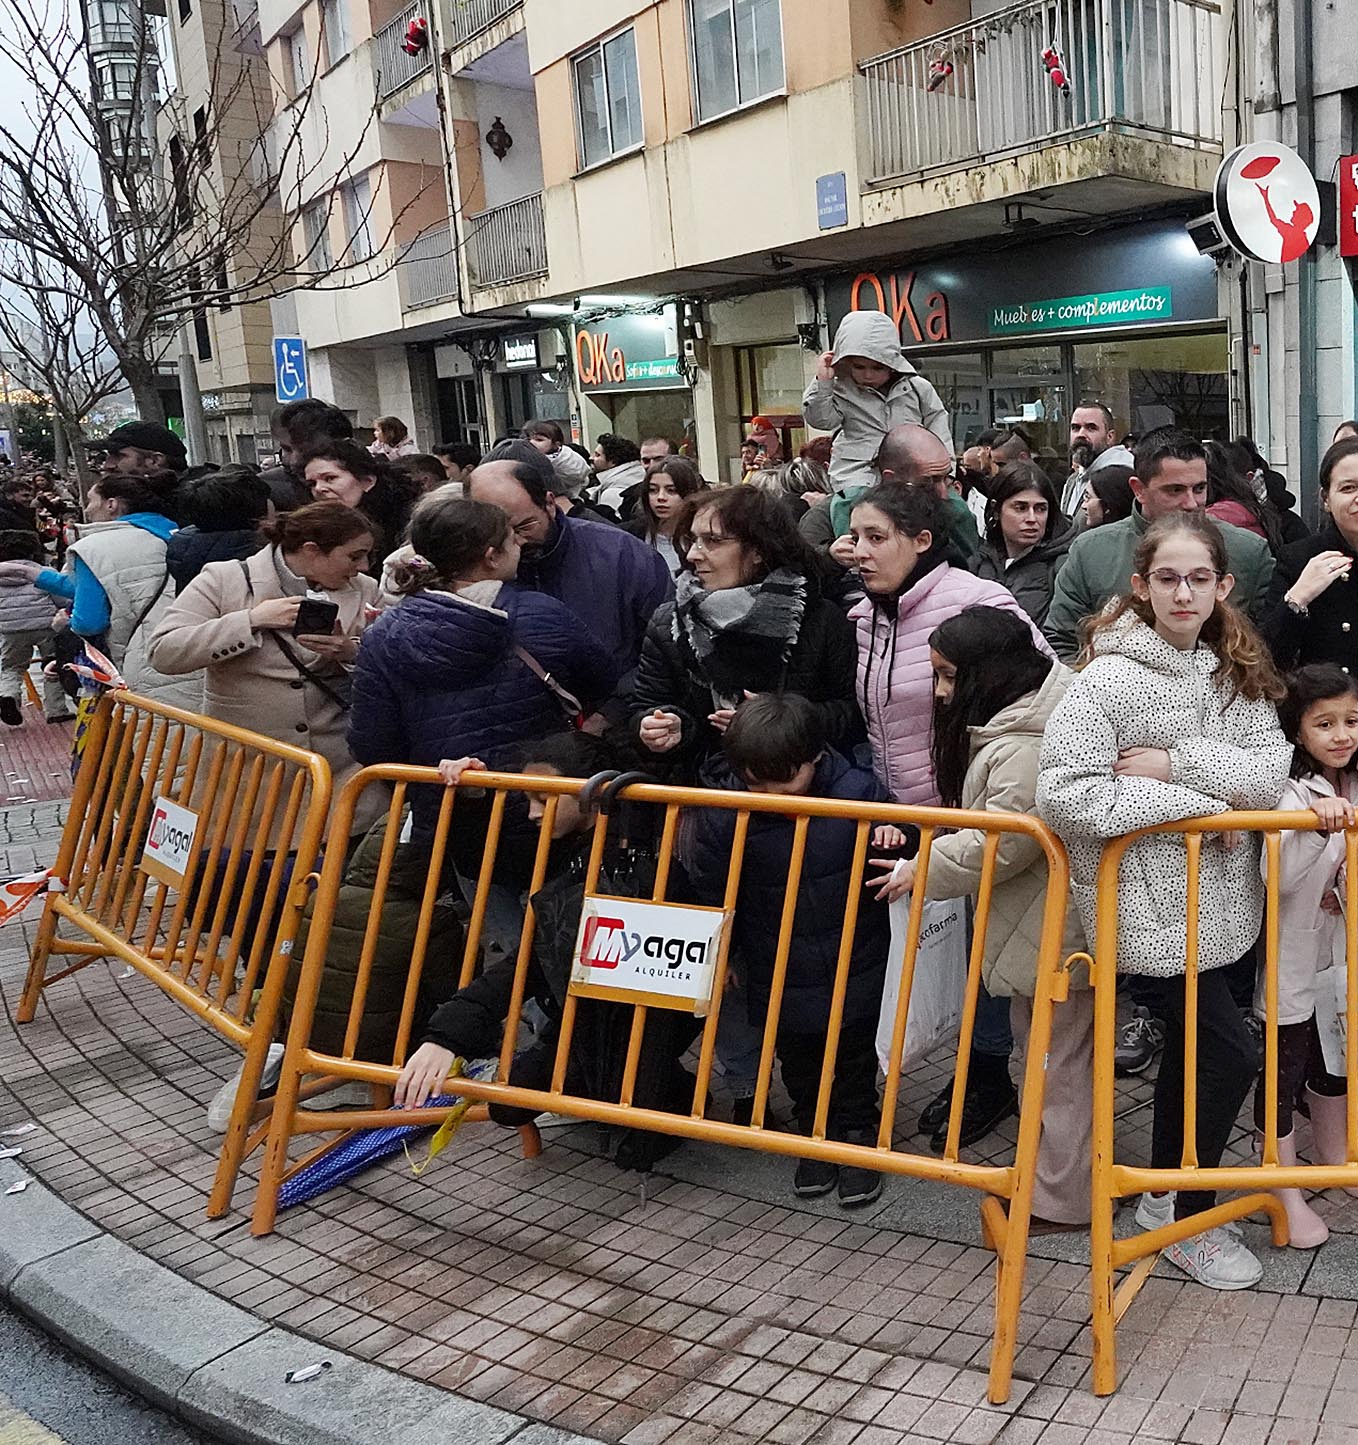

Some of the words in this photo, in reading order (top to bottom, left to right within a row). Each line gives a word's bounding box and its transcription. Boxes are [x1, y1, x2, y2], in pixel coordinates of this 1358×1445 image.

[1058, 291, 1166, 323] complementos
[576, 329, 626, 385] QKa
[635, 966, 692, 981] ALQUILER
